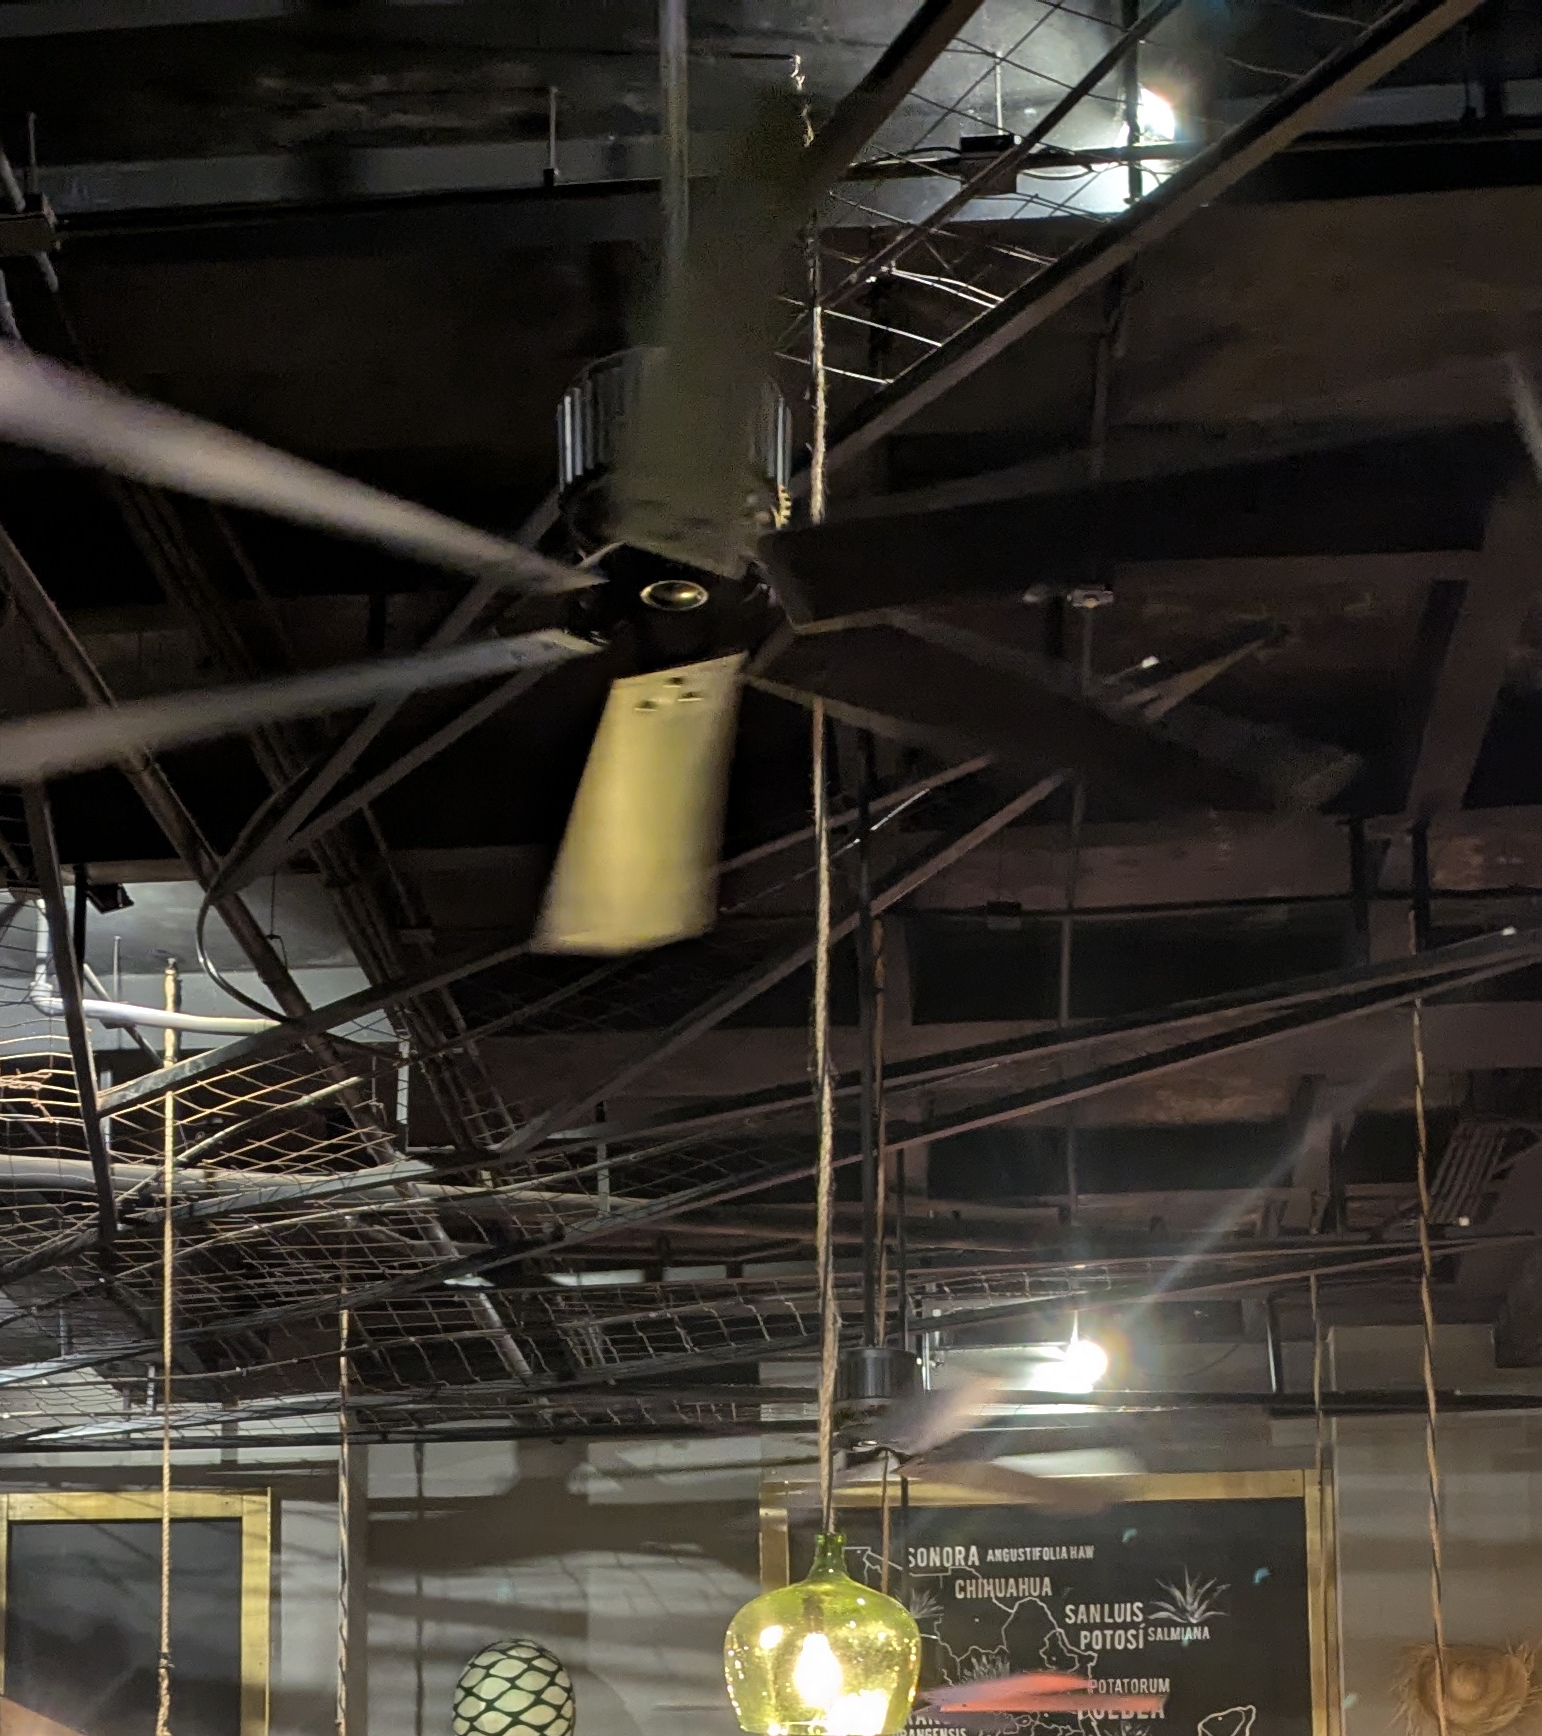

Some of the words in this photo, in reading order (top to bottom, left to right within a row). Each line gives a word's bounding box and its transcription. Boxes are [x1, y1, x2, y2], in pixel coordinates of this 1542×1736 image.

[909, 1545, 980, 1568] SONORA
[986, 1546, 1068, 1562] ANGUSTIFOLIA
[954, 1576, 1053, 1599] CHIHUAHUA
[1065, 1604, 1100, 1624] SAN
[1104, 1602, 1144, 1623] LUIS
[1080, 1623, 1146, 1650] POTOSÍ
[1147, 1626, 1210, 1642] SALMIANA
[1087, 1678, 1171, 1694] POTATORUM
